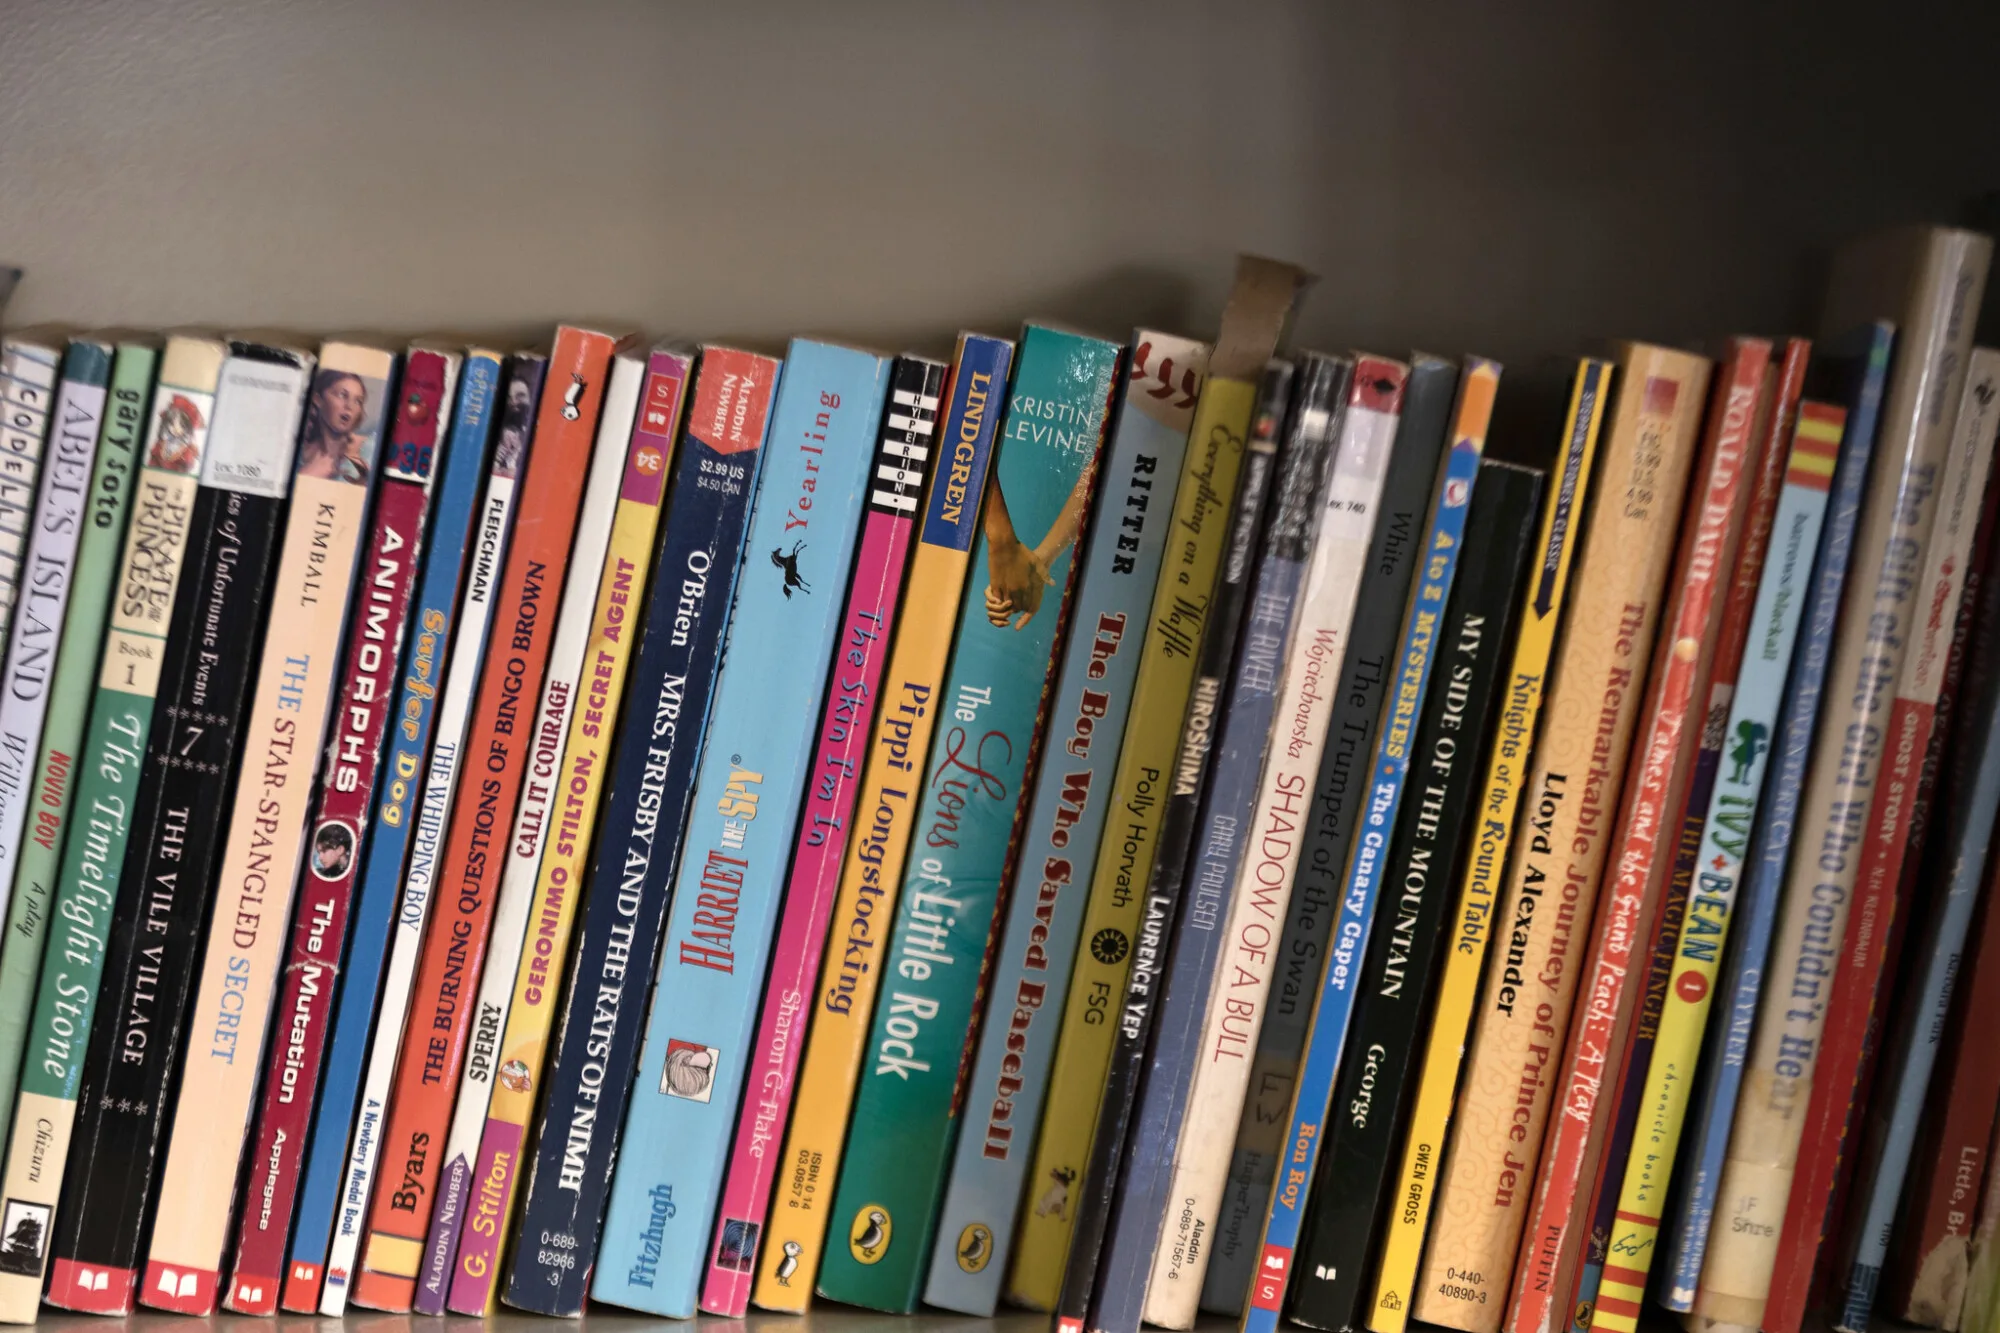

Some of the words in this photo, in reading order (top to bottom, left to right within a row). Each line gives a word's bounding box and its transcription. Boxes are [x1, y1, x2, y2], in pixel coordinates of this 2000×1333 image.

[108, 390, 139, 451] gary
[942, 372, 991, 525] LINDGREN
[1570, 389, 1596, 454] STEPPING
[44, 396, 94, 532] ABEL'S
[638, 452, 660, 470] 34
[697, 476, 720, 490] $4.50
[722, 480, 740, 495] CAN
[700, 460, 727, 475] $2.99
[729, 466, 744, 479] US
[785, 391, 840, 531] Yearling
[1557, 454, 1582, 507] STONES
[1894, 459, 1936, 525] The
[95, 459, 126, 528] soto
[1112, 454, 1157, 574] RITTER
[301, 504, 335, 606] KIMBALL
[472, 499, 504, 602] FLEISCHMAN
[1380, 513, 1412, 575] White
[1543, 518, 1568, 574] CLASSIC
[1880, 533, 1921, 603] Gift
[12, 554, 65, 701] ISLAND
[847, 606, 884, 667] The
[1256, 592, 1290, 628] THE
[1458, 615, 1484, 658] MY
[1616, 601, 1647, 656] The
[1870, 615, 1901, 650] of
[118, 641, 152, 659] Book
[126, 664, 134, 685] 1
[336, 526, 403, 791] ANIMORPHS
[393, 605, 445, 741] Surfer
[1089, 614, 1125, 678] The
[1241, 633, 1280, 692] RIVER
[278, 655, 310, 712] THE
[829, 678, 868, 745] Skin
[955, 685, 991, 721] The
[1288, 630, 1337, 759] Wojciechowska
[1350, 656, 1384, 707] The
[1441, 665, 1471, 729] SIDE
[1502, 669, 1539, 757] Knights
[1854, 656, 1896, 715] the
[100, 714, 141, 783] The
[882, 683, 930, 772] Pippi
[1073, 690, 1108, 757] Boy
[1176, 679, 1218, 794] HIROSHIMA
[1894, 712, 1918, 777] GHOST
[42, 750, 71, 807] NOVIO
[427, 738, 455, 780] THE
[525, 867, 567, 1005] GERONIMO
[557, 750, 597, 857] STILTON,
[583, 651, 614, 738] SECRET
[603, 558, 634, 642] AGENT
[817, 754, 854, 803] I'm
[918, 725, 1012, 848] Lions
[1319, 720, 1368, 840] Trumpet
[1432, 738, 1455, 776] OF
[1496, 764, 1511, 785] of
[1573, 668, 1632, 855] Remarkable
[1837, 721, 1882, 790] Girl
[383, 754, 417, 824] Dog
[718, 769, 763, 820] SPY
[1052, 772, 1091, 847] Who
[1127, 768, 1159, 817] Polly
[1416, 785, 1447, 839] THE
[1489, 788, 1508, 813] the
[1531, 773, 1566, 854] Lloyd
[1880, 782, 1904, 843] STORY
[34, 812, 61, 850] BOY
[160, 808, 189, 861] THE
[234, 718, 295, 949] STAR-SPANGLED
[406, 782, 446, 883] WHIPPING
[721, 821, 747, 850] THE
[807, 813, 842, 850] In
[1250, 773, 1305, 920] SHADOW
[1472, 819, 1505, 895] Round
[1673, 814, 1702, 869] THE
[1819, 797, 1867, 878] Who
[32, 882, 47, 897] A
[62, 796, 125, 965] Timelight
[919, 858, 950, 886] of
[1112, 824, 1147, 907] Horvath
[1311, 848, 1334, 880] of
[16, 897, 38, 937] play
[147, 873, 177, 935] VILE
[308, 899, 335, 952] The
[396, 886, 425, 930] BOY
[680, 850, 748, 975] HARRIET
[826, 788, 907, 1015] Longstocking
[1026, 858, 1070, 968] Saved
[1299, 887, 1329, 930] the
[1380, 848, 1431, 998] MOUNTAIN
[1458, 902, 1490, 954] Table
[1540, 864, 1588, 993] Journey
[1655, 866, 1690, 947] MAGIC
[899, 891, 961, 979] Little
[1131, 897, 1170, 995] LAURENCE
[1240, 924, 1270, 964] OF
[1497, 864, 1545, 1017] Alexander
[1787, 884, 1847, 1022] Couldn't
[123, 946, 163, 1065] VILLAGE
[1085, 982, 1110, 1024] FSG
[1231, 965, 1260, 987] A
[1279, 940, 1317, 1014] Swan
[1634, 950, 1672, 1043] FINGER
[44, 974, 89, 1080] Stone
[212, 956, 250, 1064] SECRET
[280, 963, 321, 1102] Mutation
[769, 989, 801, 1065] Sharon
[877, 992, 939, 1079] Rock
[1123, 1004, 1147, 1038] YEP
[1214, 998, 1254, 1062] BULL
[1534, 1004, 1555, 1039] of
[1725, 967, 1759, 1066] CLYMER
[469, 1002, 501, 1082] SPERRY
[985, 980, 1045, 1159] Baseball
[367, 1099, 380, 1107] A
[763, 1070, 784, 1096] G.
[1351, 1044, 1385, 1128] George
[1510, 1044, 1550, 1142] Prince
[1652, 1064, 1678, 1142] chronicle
[1763, 1033, 1815, 1121] Hear
[29, 1118, 51, 1182] Chizuru
[349, 1110, 378, 1164] Newbery
[750, 1100, 778, 1159] Flake
[1294, 1122, 1316, 1162] Ron
[260, 1129, 286, 1230] Applegate
[348, 1169, 366, 1205] Medal
[391, 1132, 429, 1213] Byars
[792, 1150, 809, 1196] 03.0957
[808, 1153, 822, 1182] ISBN
[1280, 1169, 1305, 1210] Roy
[1413, 1144, 1431, 1179] GWEN
[1496, 1151, 1525, 1207] Jen
[1638, 1155, 1660, 1200] books
[1949, 1146, 1979, 1206] Little,
[341, 1208, 358, 1236] Book
[789, 1200, 799, 1208] 8
[802, 1198, 812, 1209] 14
[1404, 1184, 1422, 1224] GROSS
[538, 1250, 574, 1269] 82966
[541, 1231, 578, 1249] 0-689-
[628, 1184, 676, 1289] Fitzhugh
[1168, 1198, 1195, 1279] 0-689-71567-6
[1187, 1219, 1205, 1264] Aladdin
[1535, 1226, 1561, 1292] PUFFIN
[1439, 1284, 1487, 1306] 40890-3
[1448, 1268, 1485, 1285] 0-440-
